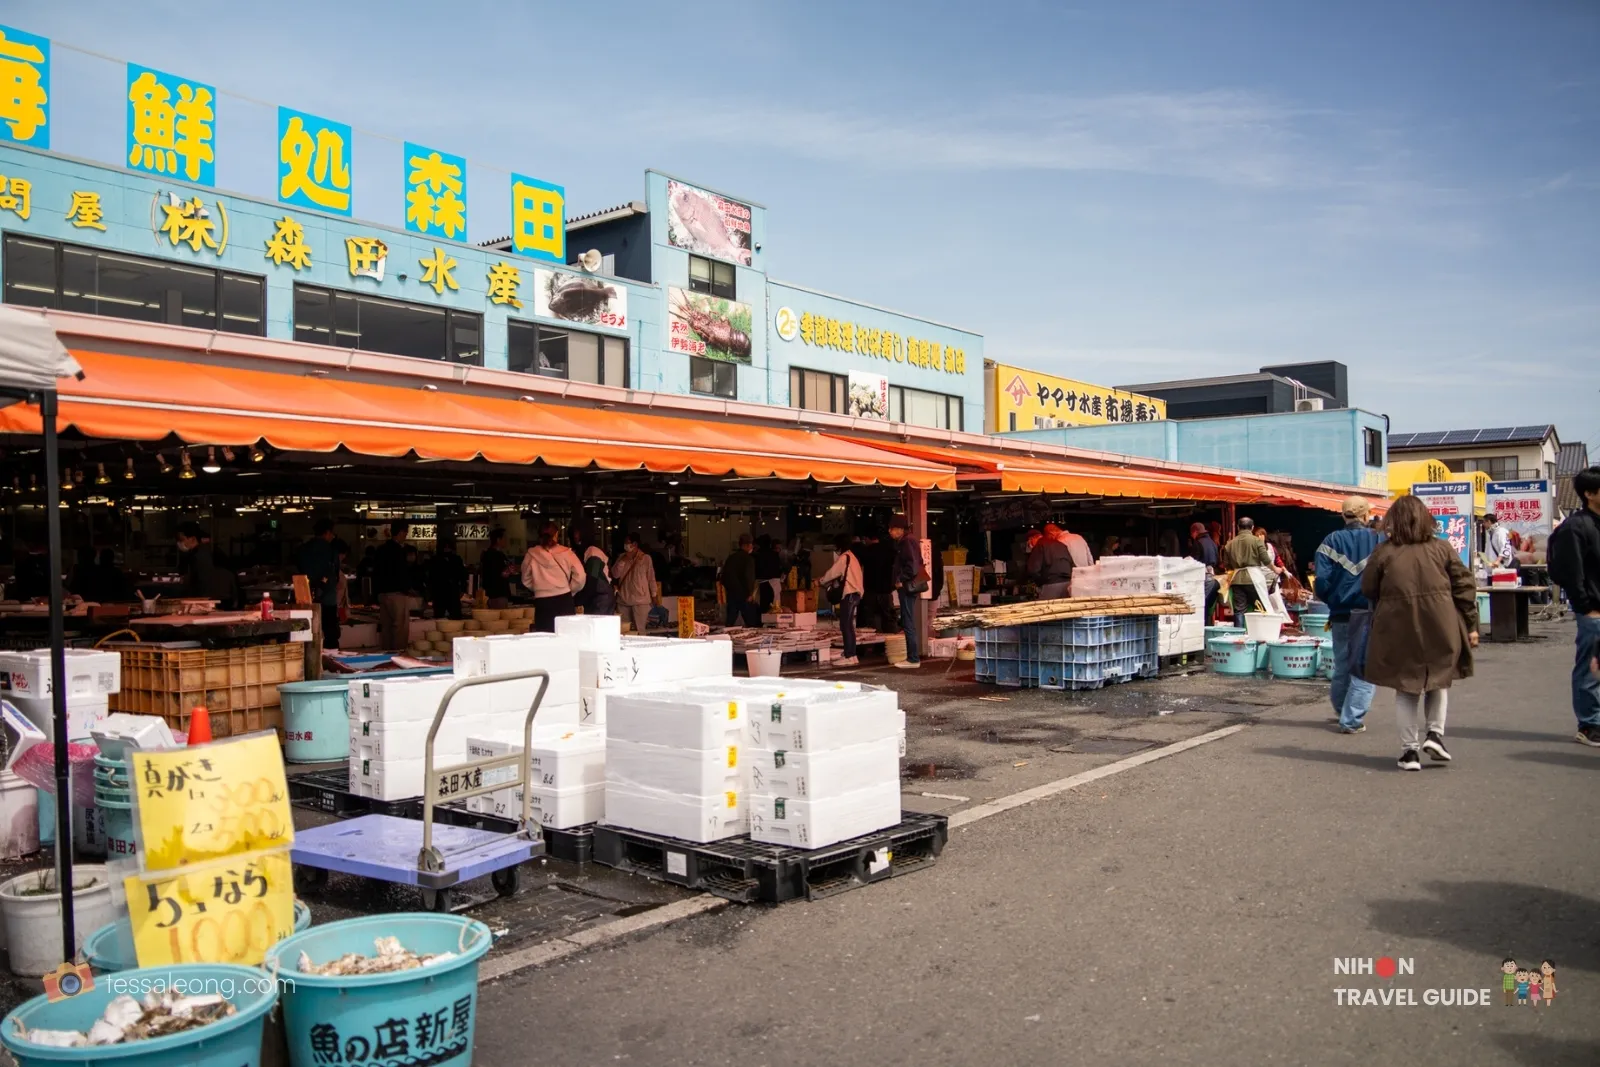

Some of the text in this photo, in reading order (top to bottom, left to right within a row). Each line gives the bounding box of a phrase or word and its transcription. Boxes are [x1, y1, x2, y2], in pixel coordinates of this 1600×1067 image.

[600, 312, 625, 326] ヒラメ
[671, 321, 688, 334] 天然
[671, 338, 706, 355] 伊勢海老
[1443, 485, 1468, 493] 1F/2F
[1495, 500, 1540, 511] 海鮮 和風
[1495, 511, 1541, 521] レストラン
[142, 759, 222, 798] 真がき
[438, 767, 482, 797] 森田水産
[310, 995, 472, 1064] 魚の店新屋
